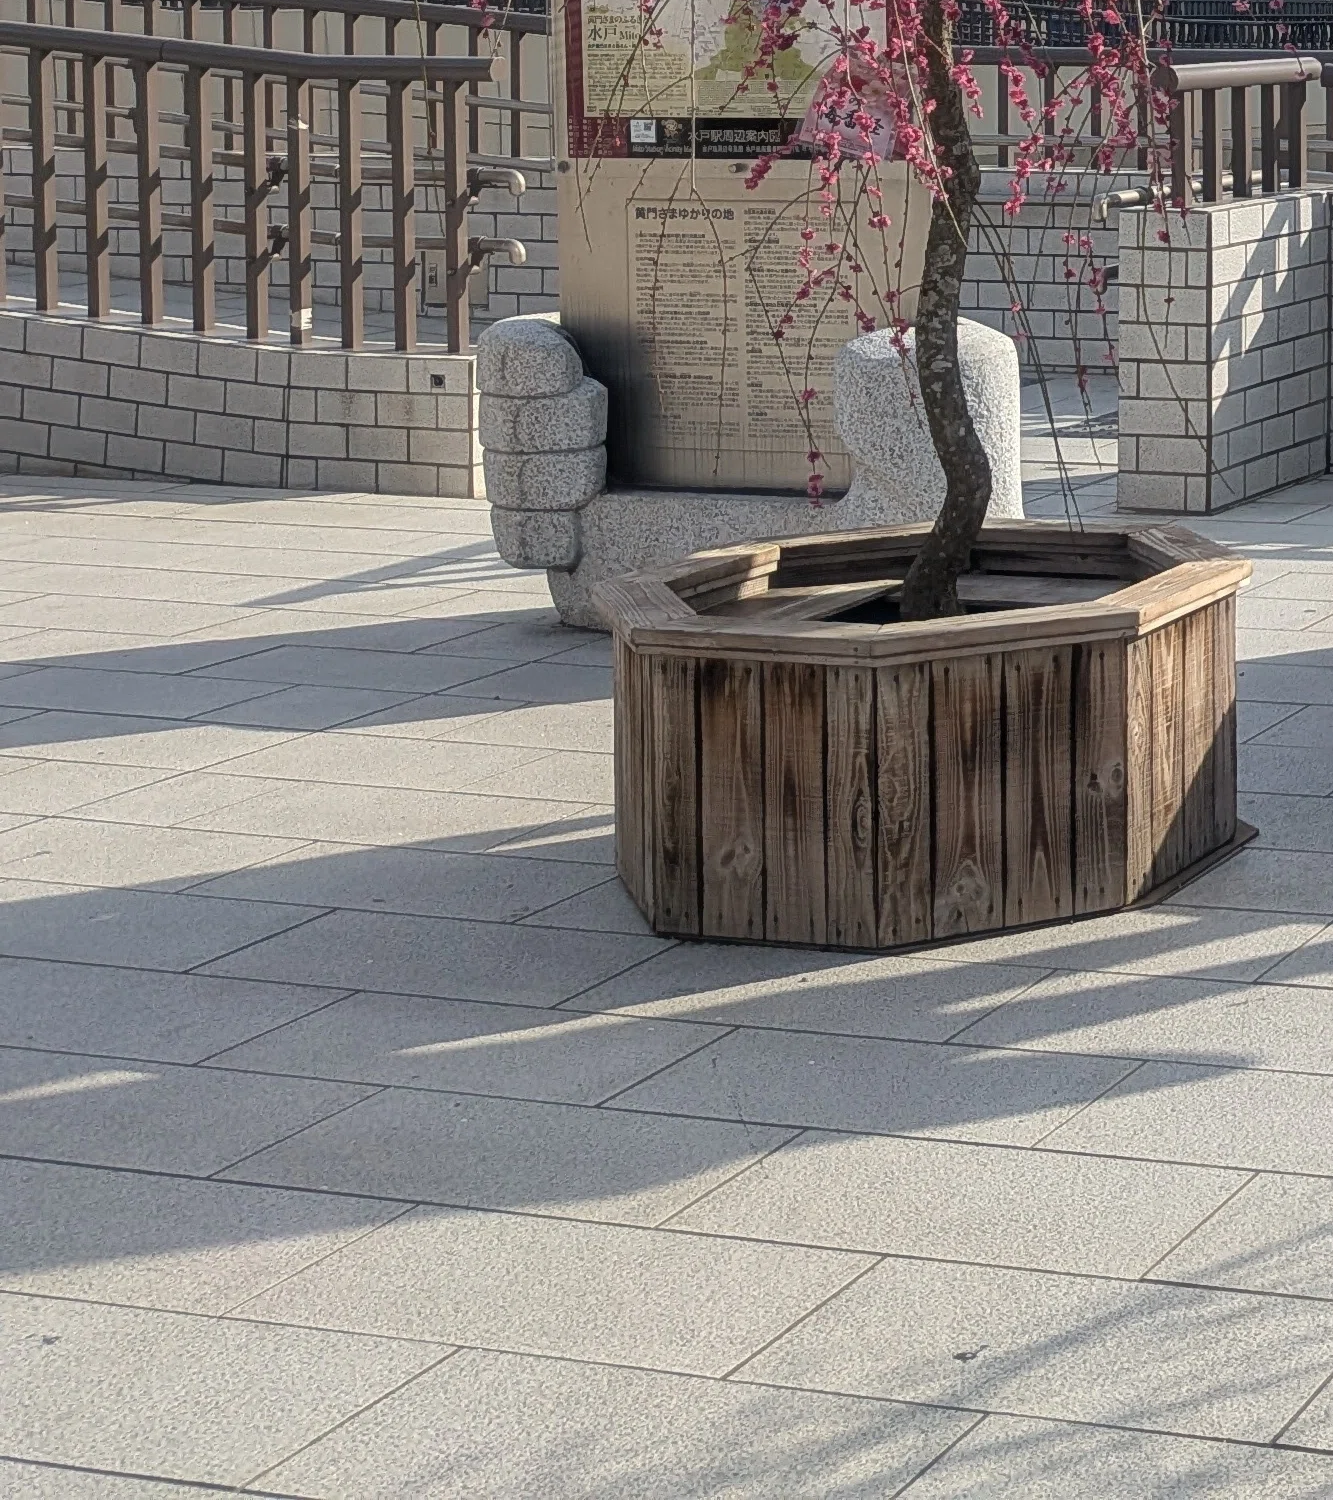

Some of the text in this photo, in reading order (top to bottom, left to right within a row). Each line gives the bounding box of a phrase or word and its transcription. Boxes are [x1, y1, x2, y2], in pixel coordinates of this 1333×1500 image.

[587, 24, 617, 41] 水戸
[635, 206, 735, 221] 黄門さまゆかりの地
